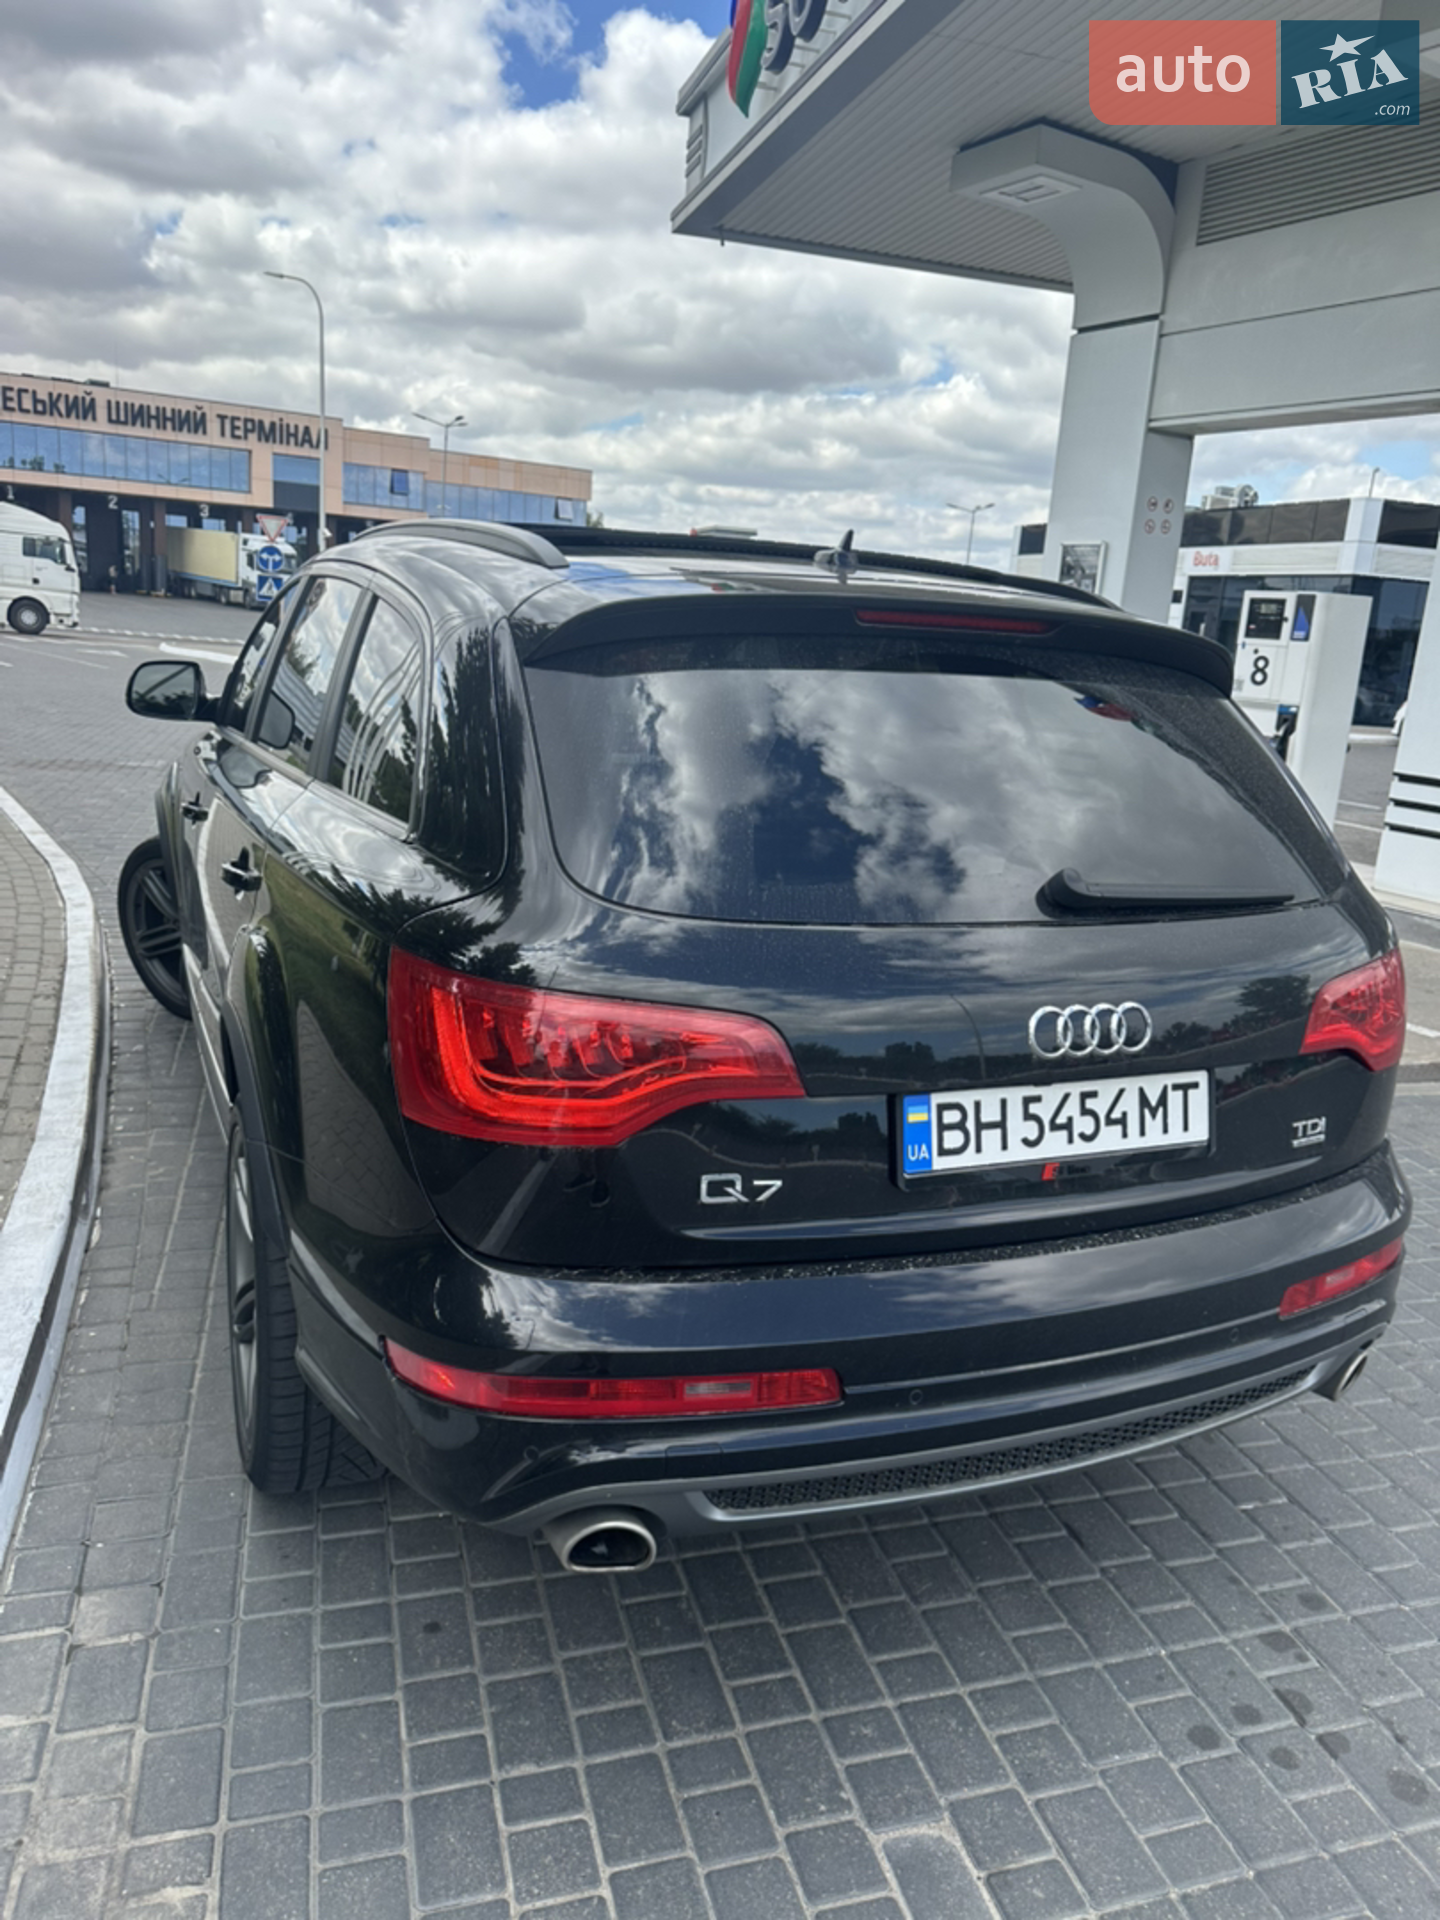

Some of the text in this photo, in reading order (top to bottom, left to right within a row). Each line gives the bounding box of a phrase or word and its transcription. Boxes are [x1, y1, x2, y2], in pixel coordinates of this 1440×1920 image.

[1, 385, 97, 422] ЕСЬКИЙ
[106, 399, 207, 436] ШИННИЙ
[6, 485, 15, 500] 1
[108, 495, 118, 510] 2
[199, 504, 209, 518] 3
[1250, 655, 1270, 687] 8
[1292, 1116, 1327, 1138] TDI
[907, 1143, 930, 1162] UA
[700, 1172, 783, 1204] Q7
